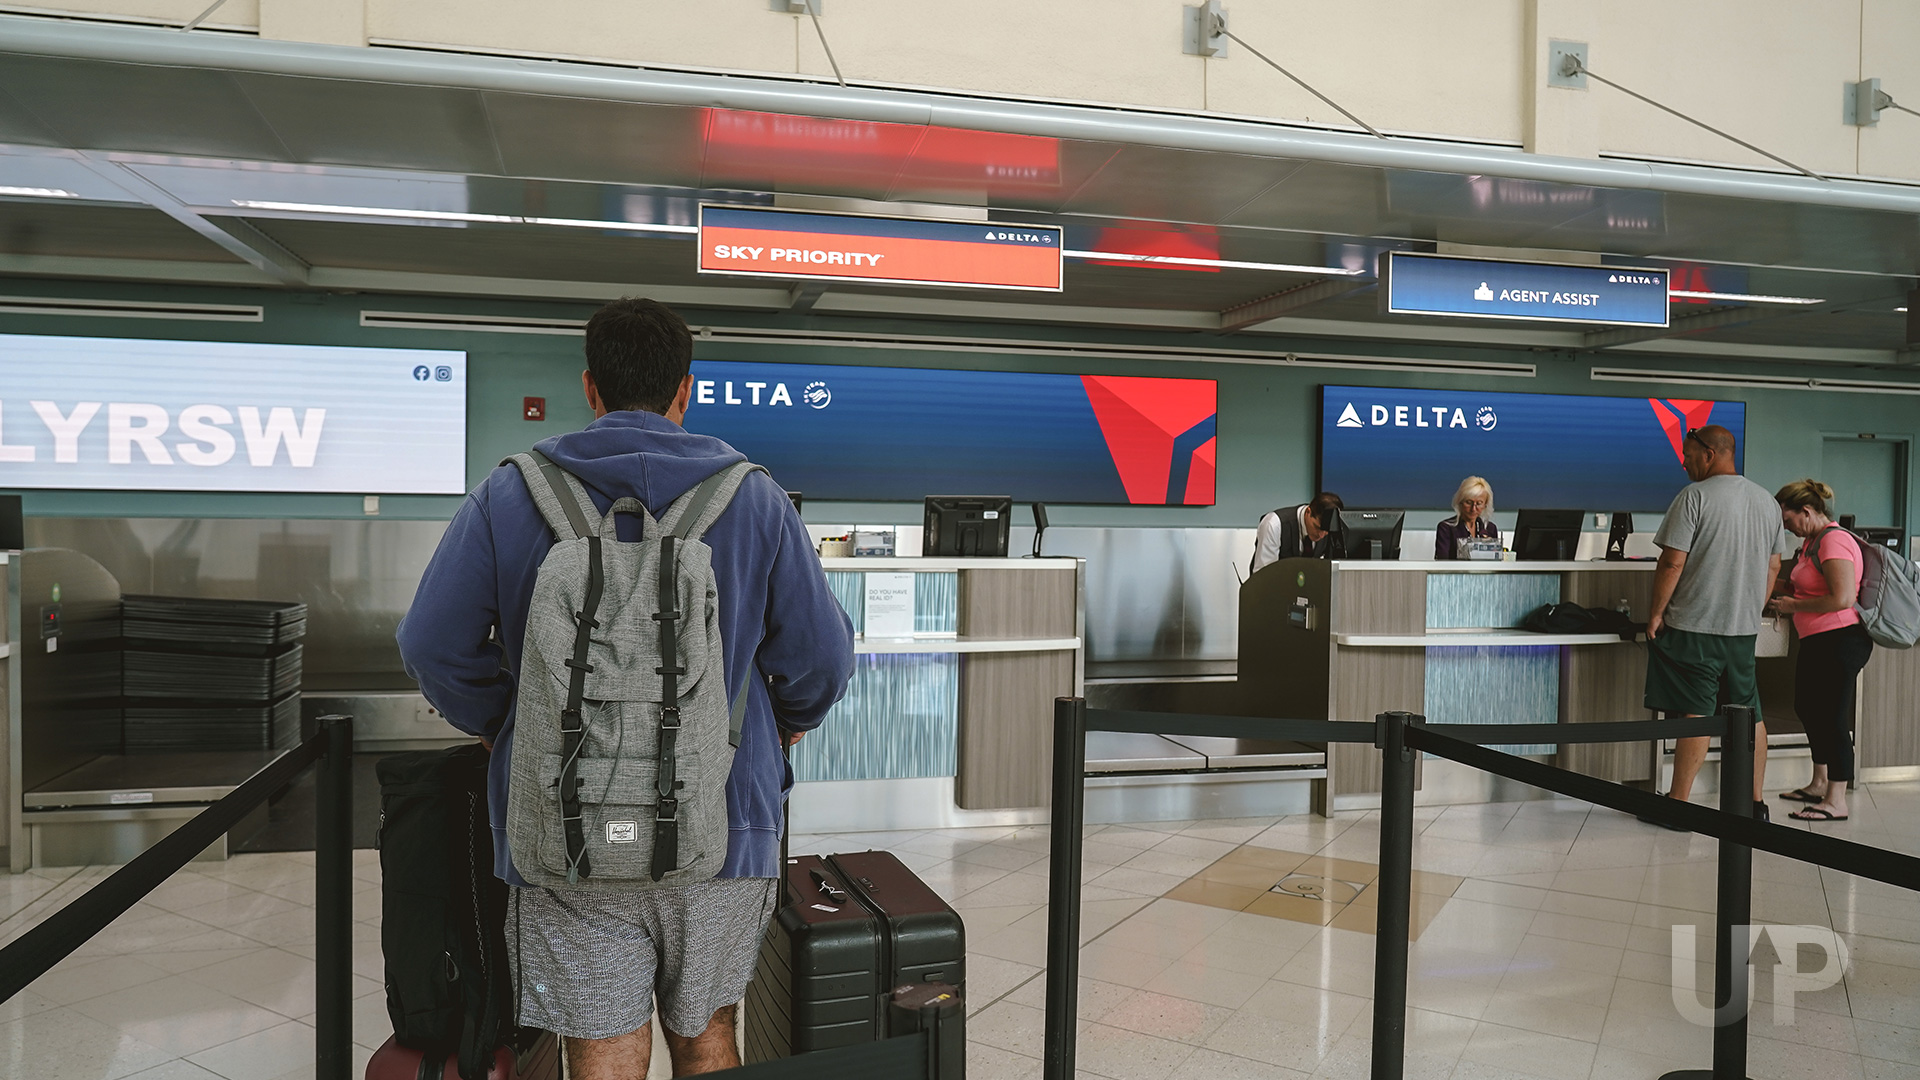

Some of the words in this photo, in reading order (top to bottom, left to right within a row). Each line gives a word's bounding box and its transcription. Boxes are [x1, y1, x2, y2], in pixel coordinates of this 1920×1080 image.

[998, 232, 1040, 243] DELTA
[714, 244, 764, 260] SKY
[770, 247, 884, 267] PRIORITY
[1618, 275, 1651, 285] DELTA
[1499, 289, 1549, 304] AGENT
[1551, 292, 1600, 307] ASSIST
[697, 380, 793, 407] ELTA
[1371, 404, 1468, 429] DELTA
